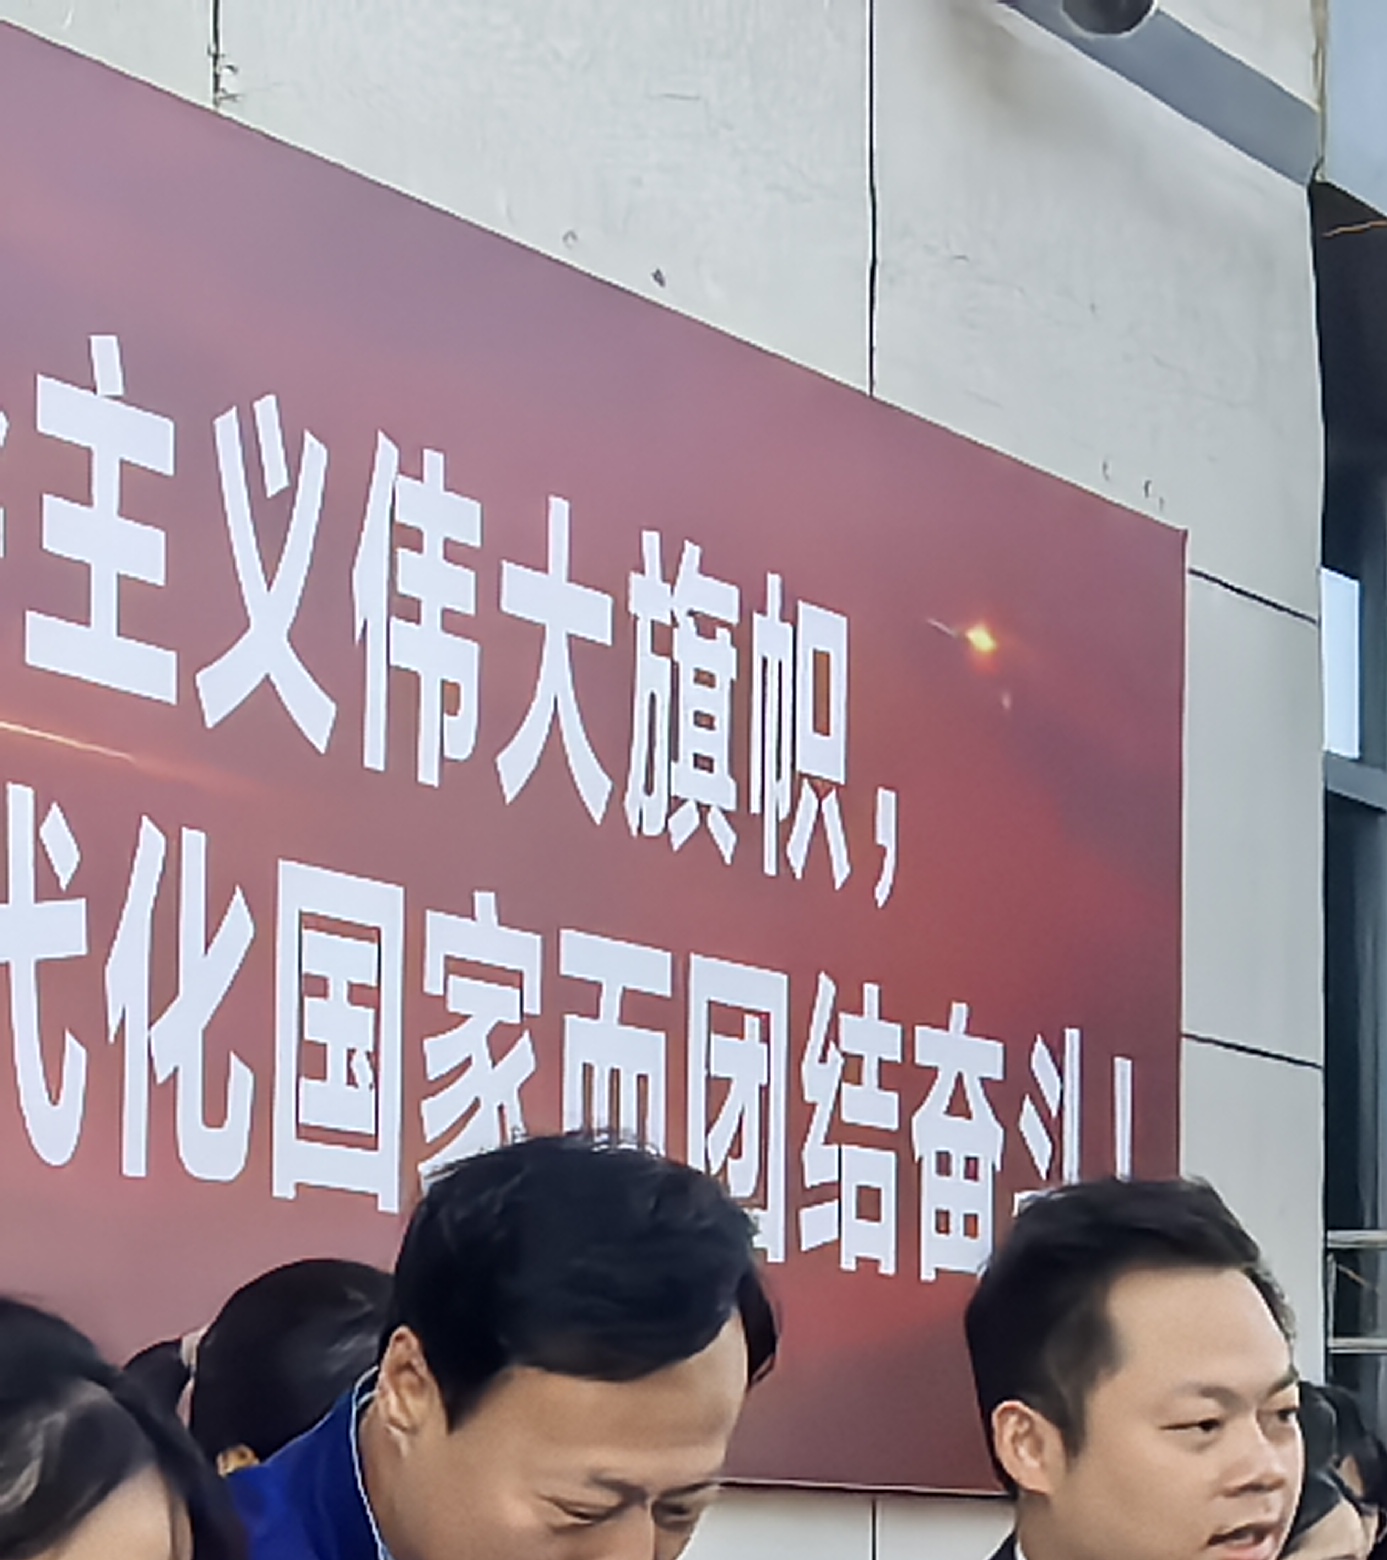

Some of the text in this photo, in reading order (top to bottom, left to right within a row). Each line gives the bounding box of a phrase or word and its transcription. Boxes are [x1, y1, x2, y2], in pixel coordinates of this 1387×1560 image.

[0, 335, 897, 907] 主义伟大旗帜，
